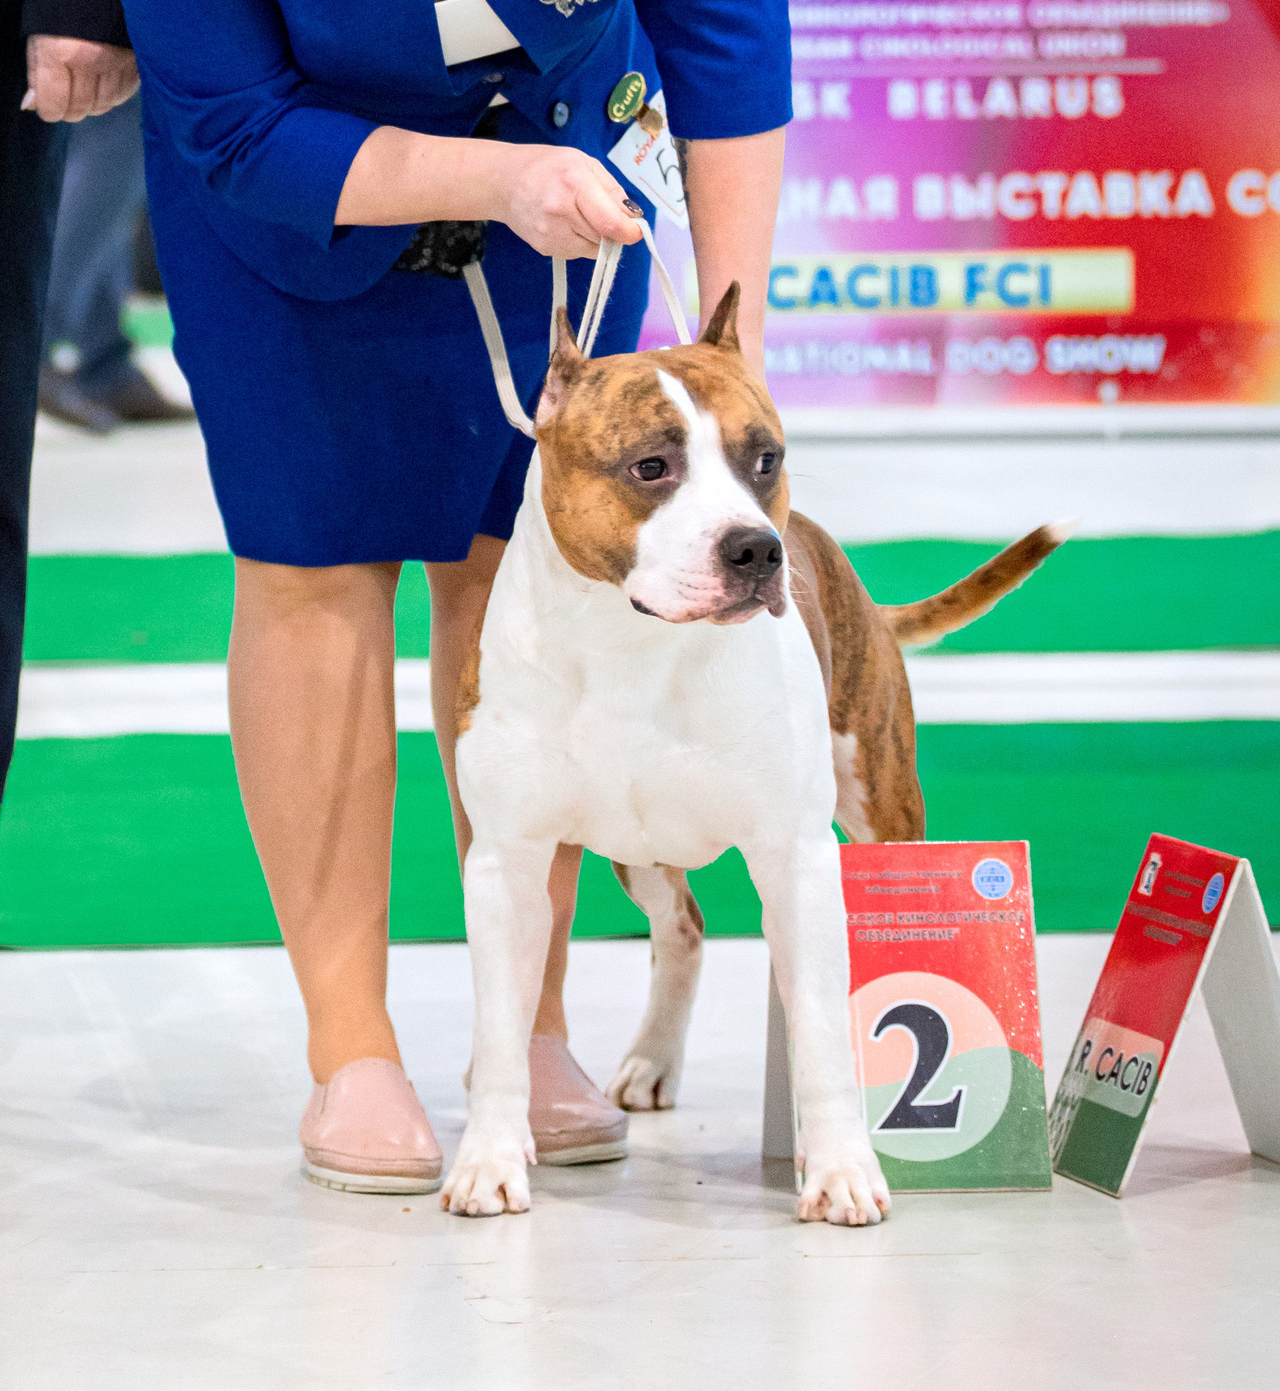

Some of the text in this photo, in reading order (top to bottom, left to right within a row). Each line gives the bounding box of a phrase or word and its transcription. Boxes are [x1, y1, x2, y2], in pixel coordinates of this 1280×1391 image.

[612, 79, 642, 118] Crufts
[792, 77, 1123, 119] SK BELARUS
[913, 170, 1214, 219] ВЫСТАВКА
[767, 263, 1052, 310] CACIB FCI
[765, 334, 1166, 375] NATIONAL DOG SHOW
[898, 911, 1026, 925] КИНОЛОГИЧЕСКОЕ
[871, 1001, 966, 1133] 2
[1075, 1039, 1152, 1096] R. CACIB
